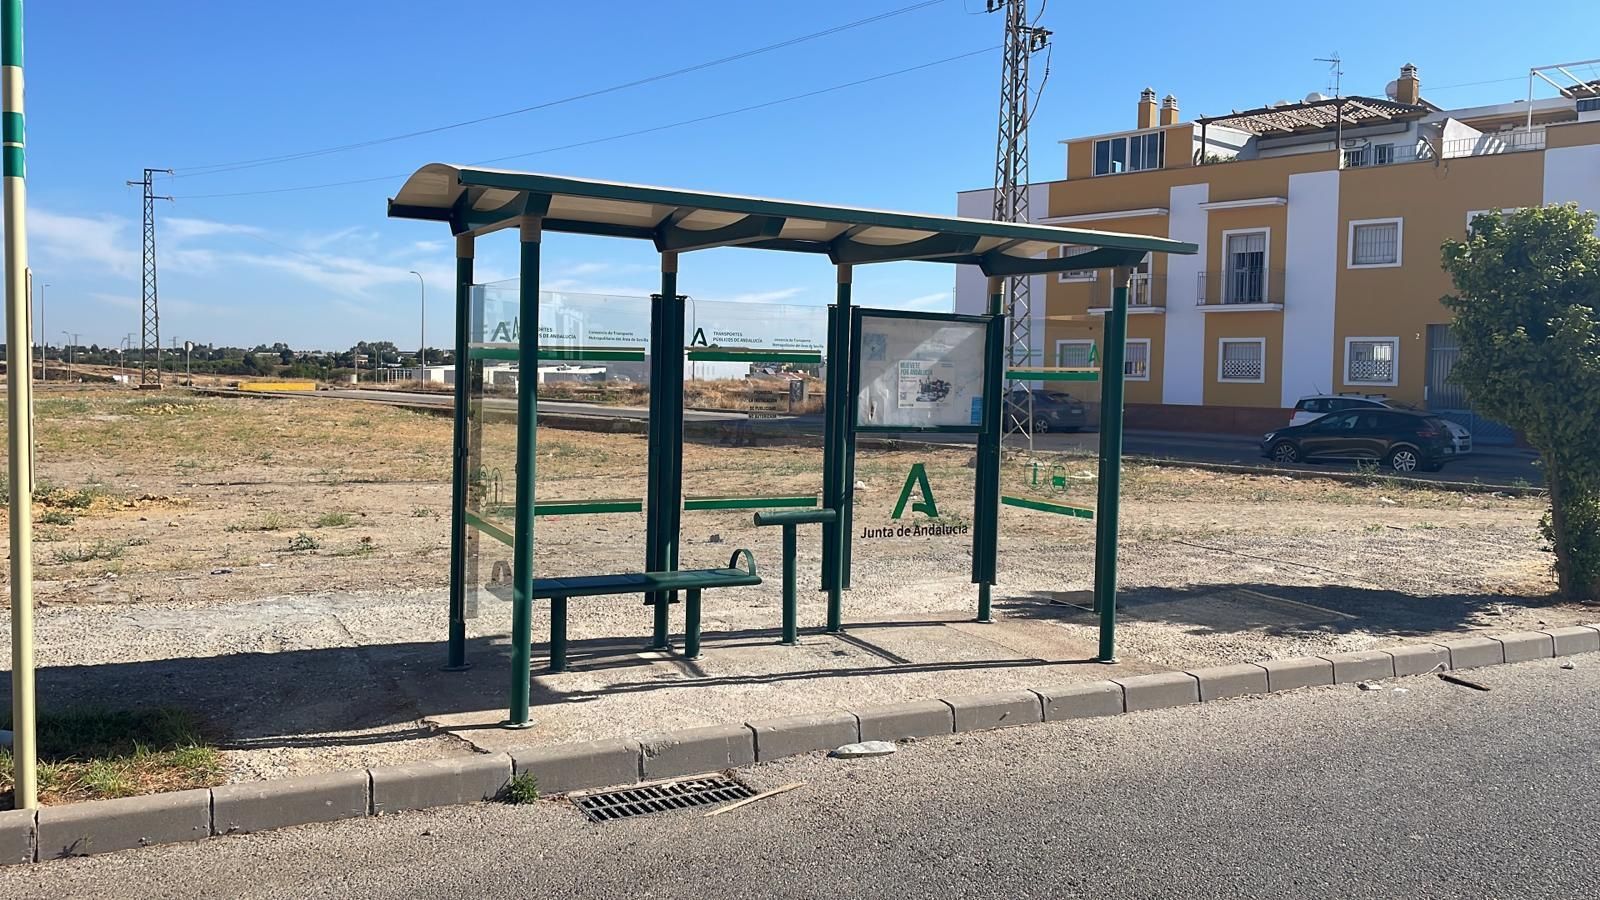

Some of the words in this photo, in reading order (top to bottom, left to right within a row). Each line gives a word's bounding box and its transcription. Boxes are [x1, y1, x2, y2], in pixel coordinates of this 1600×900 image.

[861, 527, 894, 539] Junta
[896, 525, 911, 537] de
[913, 521, 968, 537] Andalucía
